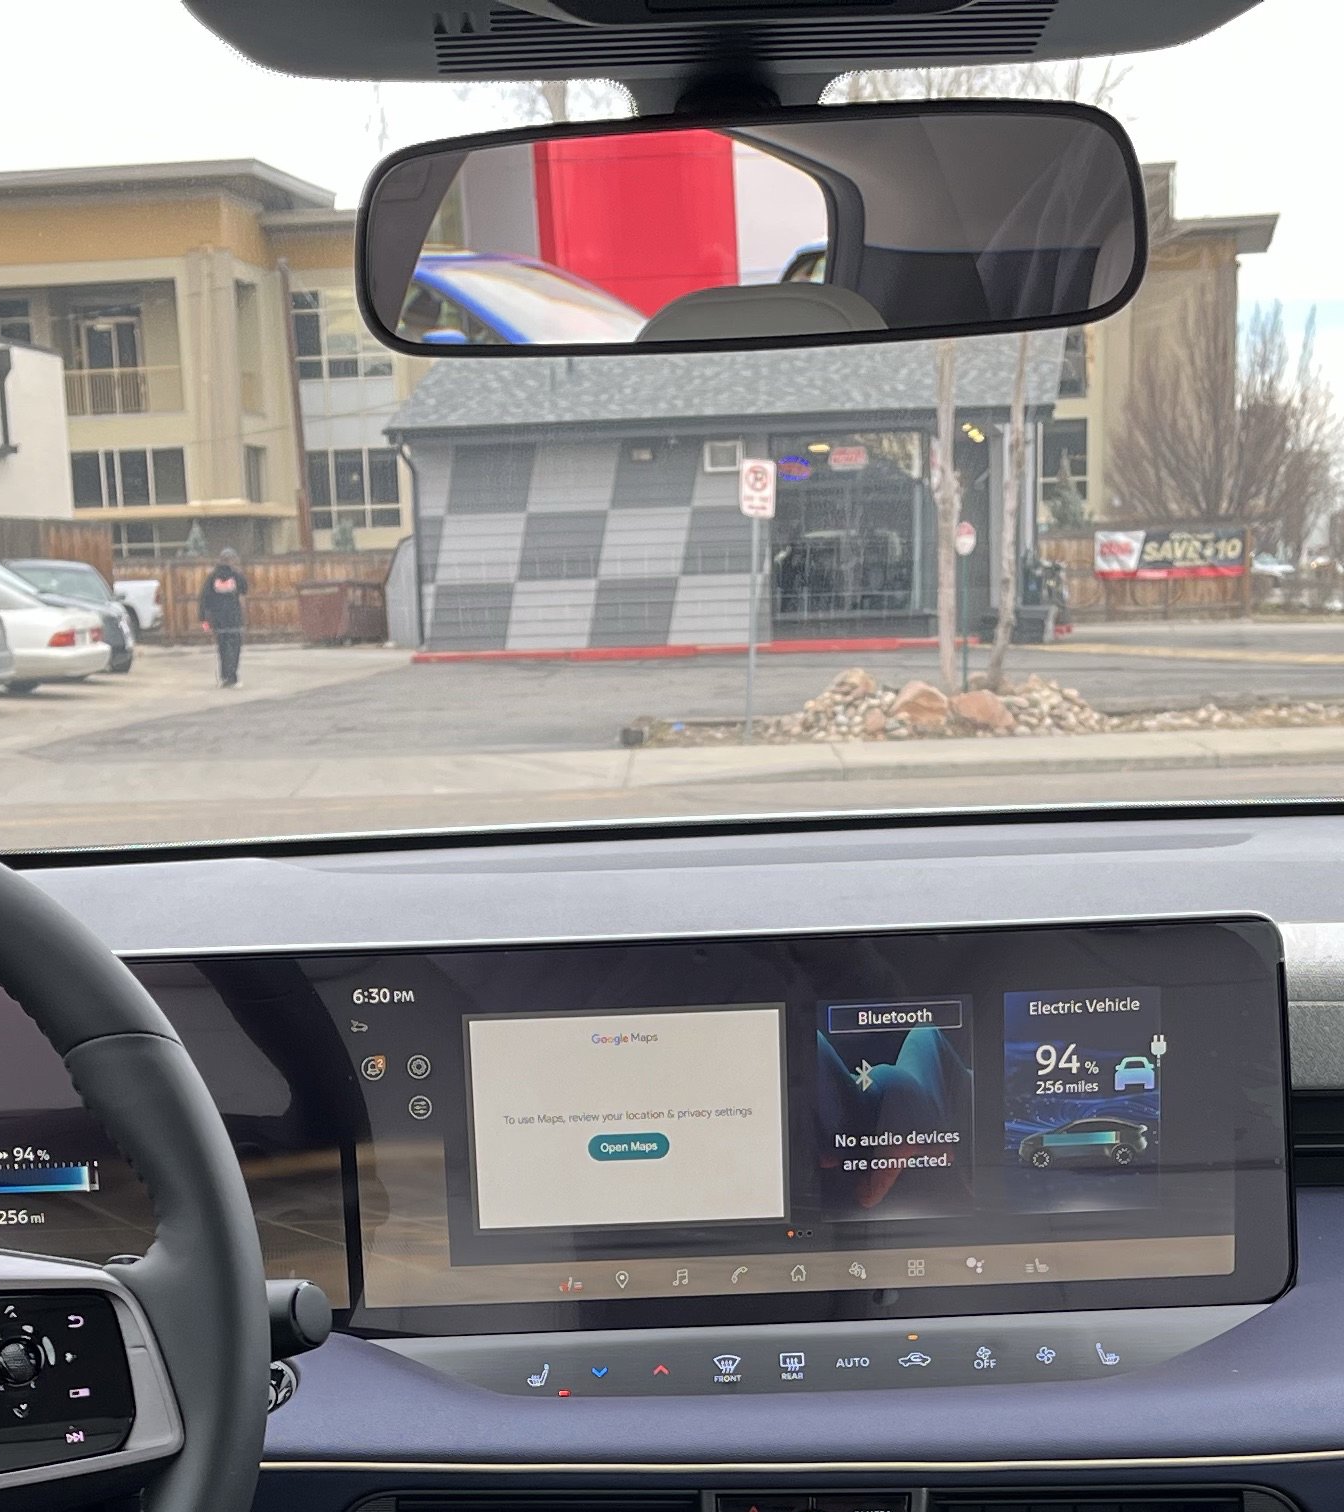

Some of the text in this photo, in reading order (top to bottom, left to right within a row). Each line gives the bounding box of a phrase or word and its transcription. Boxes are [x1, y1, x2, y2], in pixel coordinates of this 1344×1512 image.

[353, 988, 414, 1004] 6:30 PM
[1030, 997, 1140, 1015] Electric Vehicle
[858, 1008, 932, 1025] Bluetooth
[591, 1032, 658, 1045] Google Maps
[1036, 1044, 1099, 1075] 94 %
[1036, 1080, 1098, 1094] 256 miles
[504, 1115, 515, 1125] To
[518, 1115, 535, 1125] use
[568, 1112, 599, 1123] review
[602, 1111, 623, 1123] your
[626, 1109, 665, 1121] location
[668, 1110, 675, 1119] &
[678, 1108, 712, 1121] privacy
[715, 1106, 752, 1118] settings
[835, 1130, 960, 1147] No audio devices
[13, 1146, 50, 1162] 94 %
[601, 1141, 658, 1154] Open Maps
[843, 1153, 951, 1171] are connected.
[30, 1212, 45, 1224] mi
[835, 1357, 870, 1369] AUTO
[973, 1359, 997, 1370] OFF
[714, 1374, 742, 1383] FRONT
[781, 1372, 804, 1381] REAR
